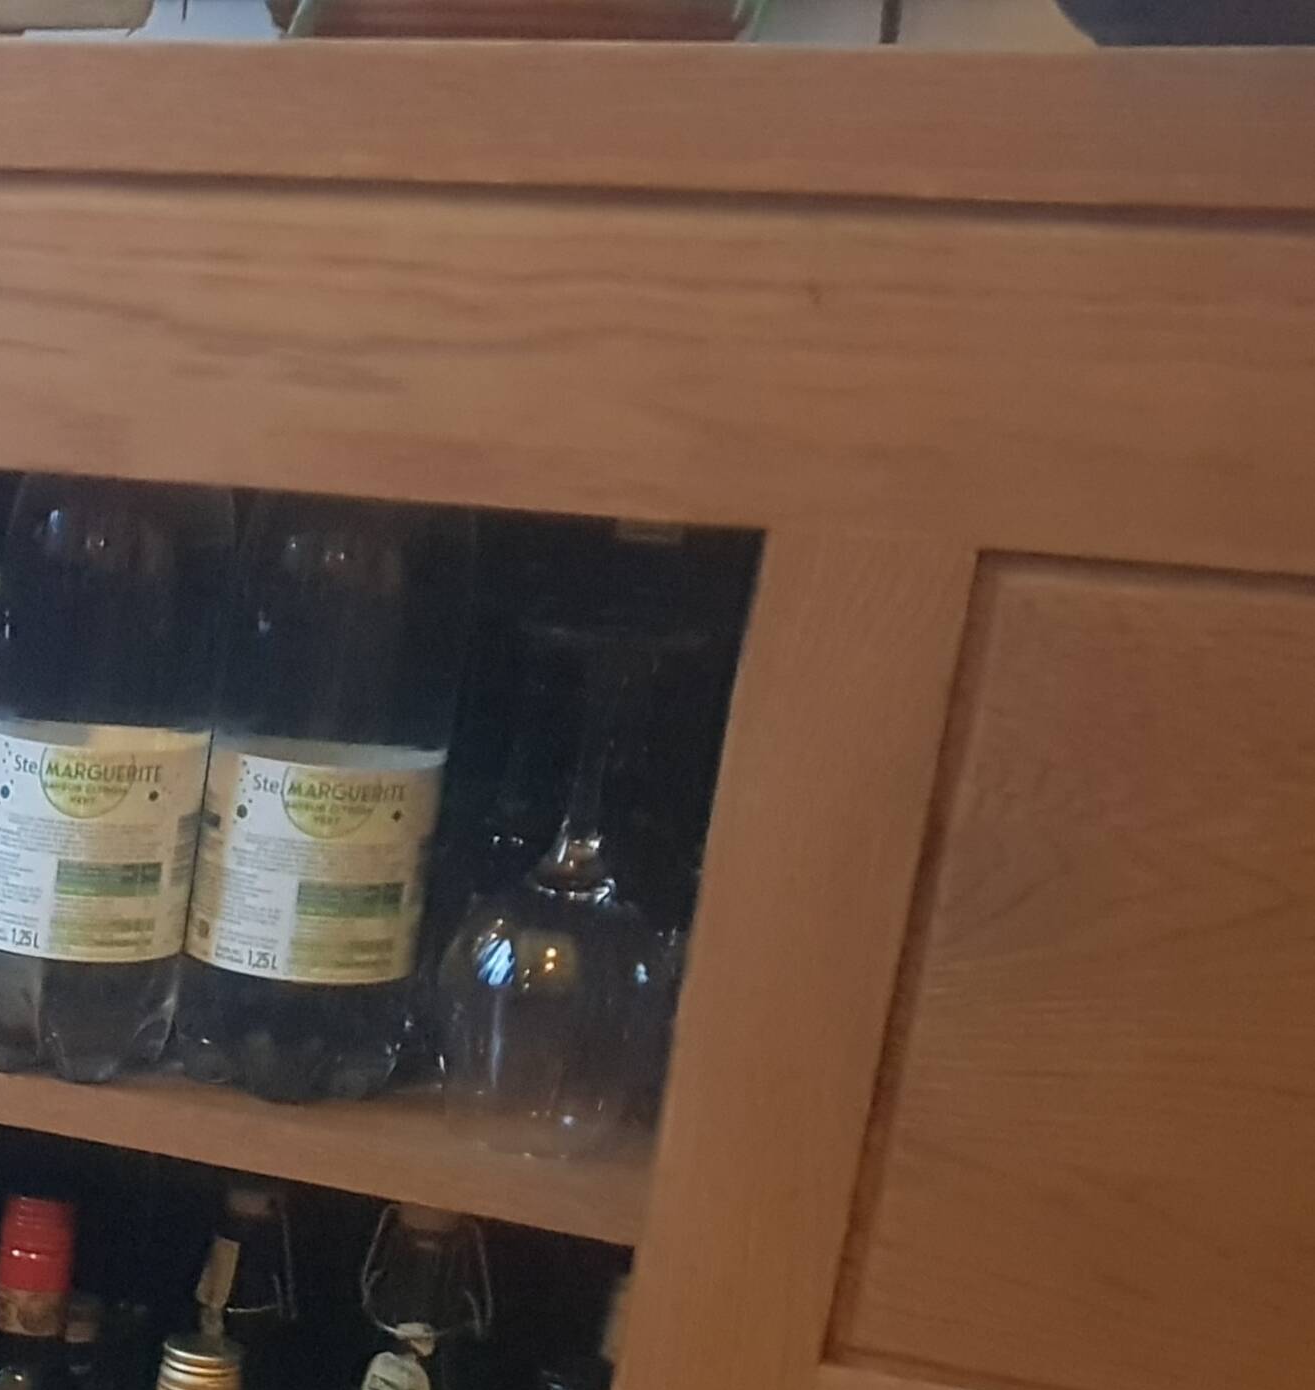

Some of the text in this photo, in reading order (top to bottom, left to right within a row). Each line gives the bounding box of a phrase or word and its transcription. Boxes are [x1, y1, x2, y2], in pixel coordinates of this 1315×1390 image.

[14, 754, 39, 775] Ste
[253, 774, 280, 794] Ste
[12, 927, 32, 946] 1,25
